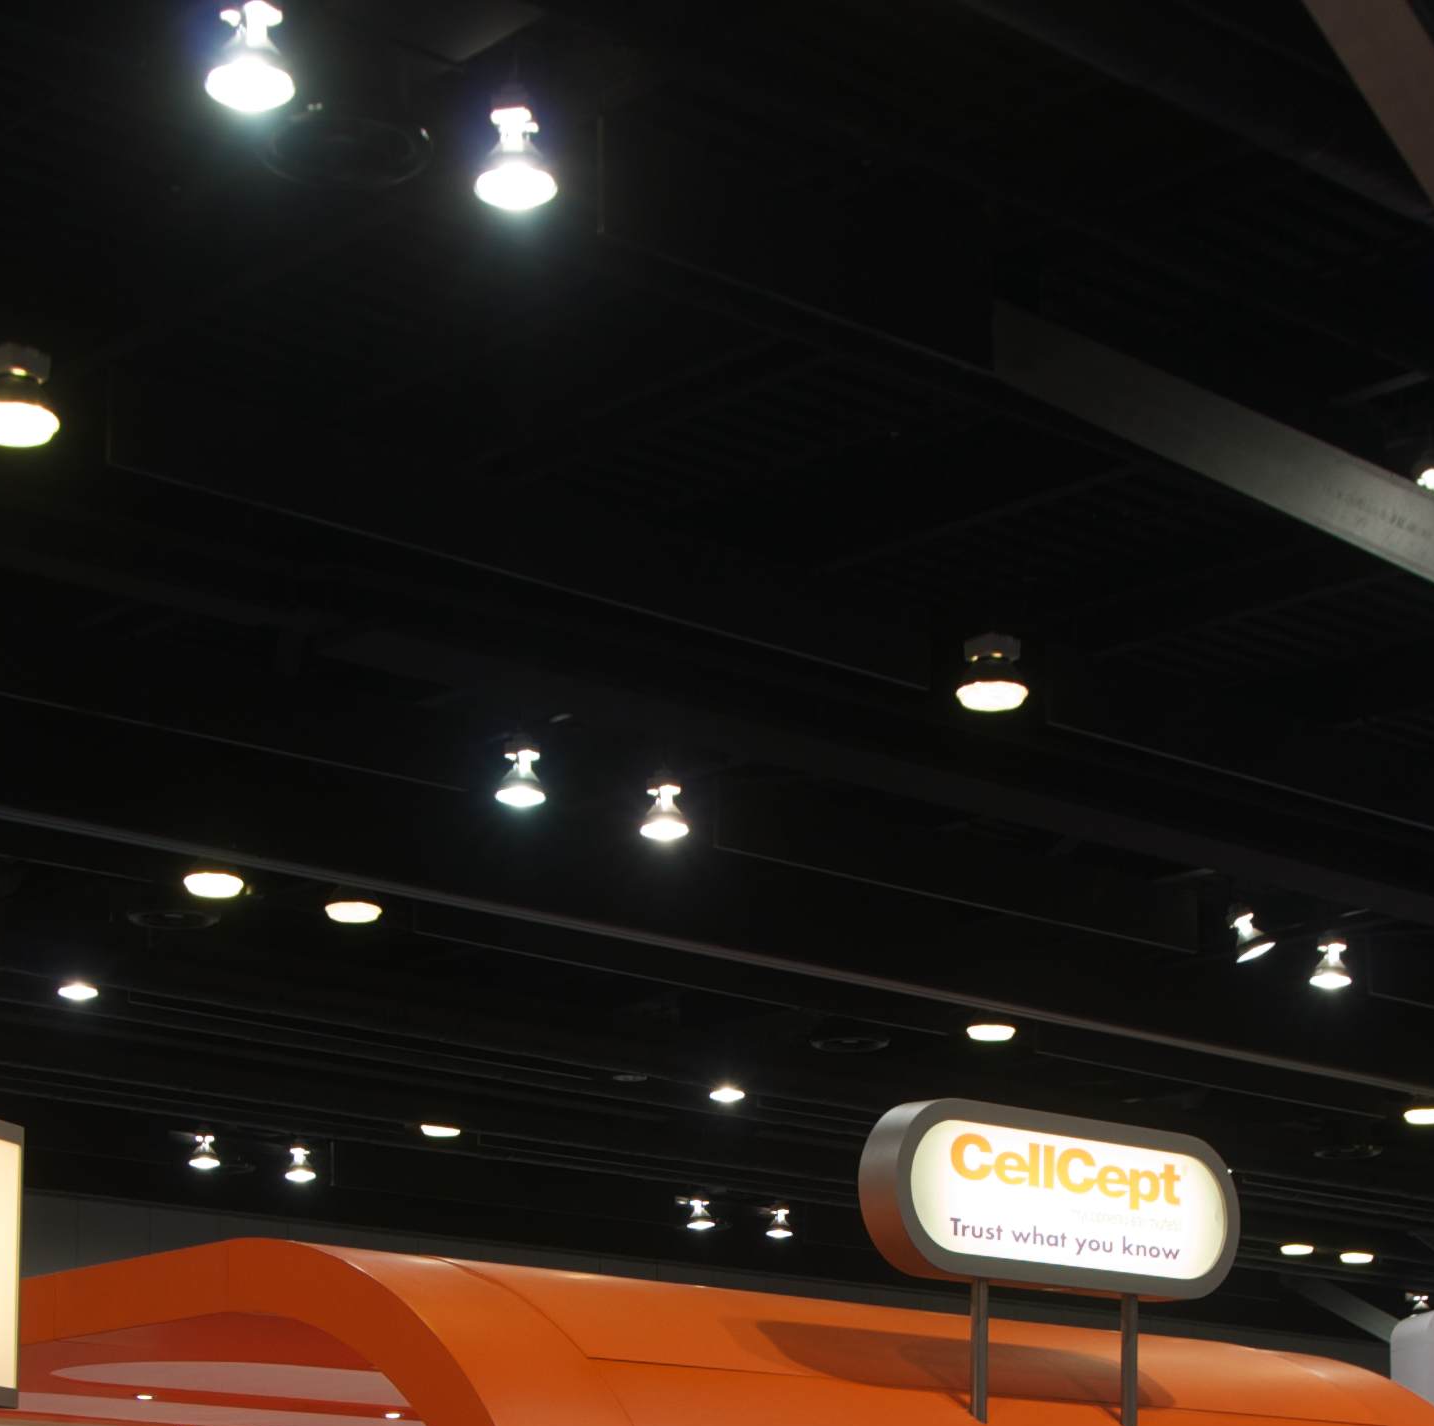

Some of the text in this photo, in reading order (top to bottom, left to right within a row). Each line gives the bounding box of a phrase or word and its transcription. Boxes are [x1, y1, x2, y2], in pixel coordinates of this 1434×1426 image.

[949, 1132, 1181, 1211] CellCept
[950, 1217, 1181, 1261] Trust what you know
